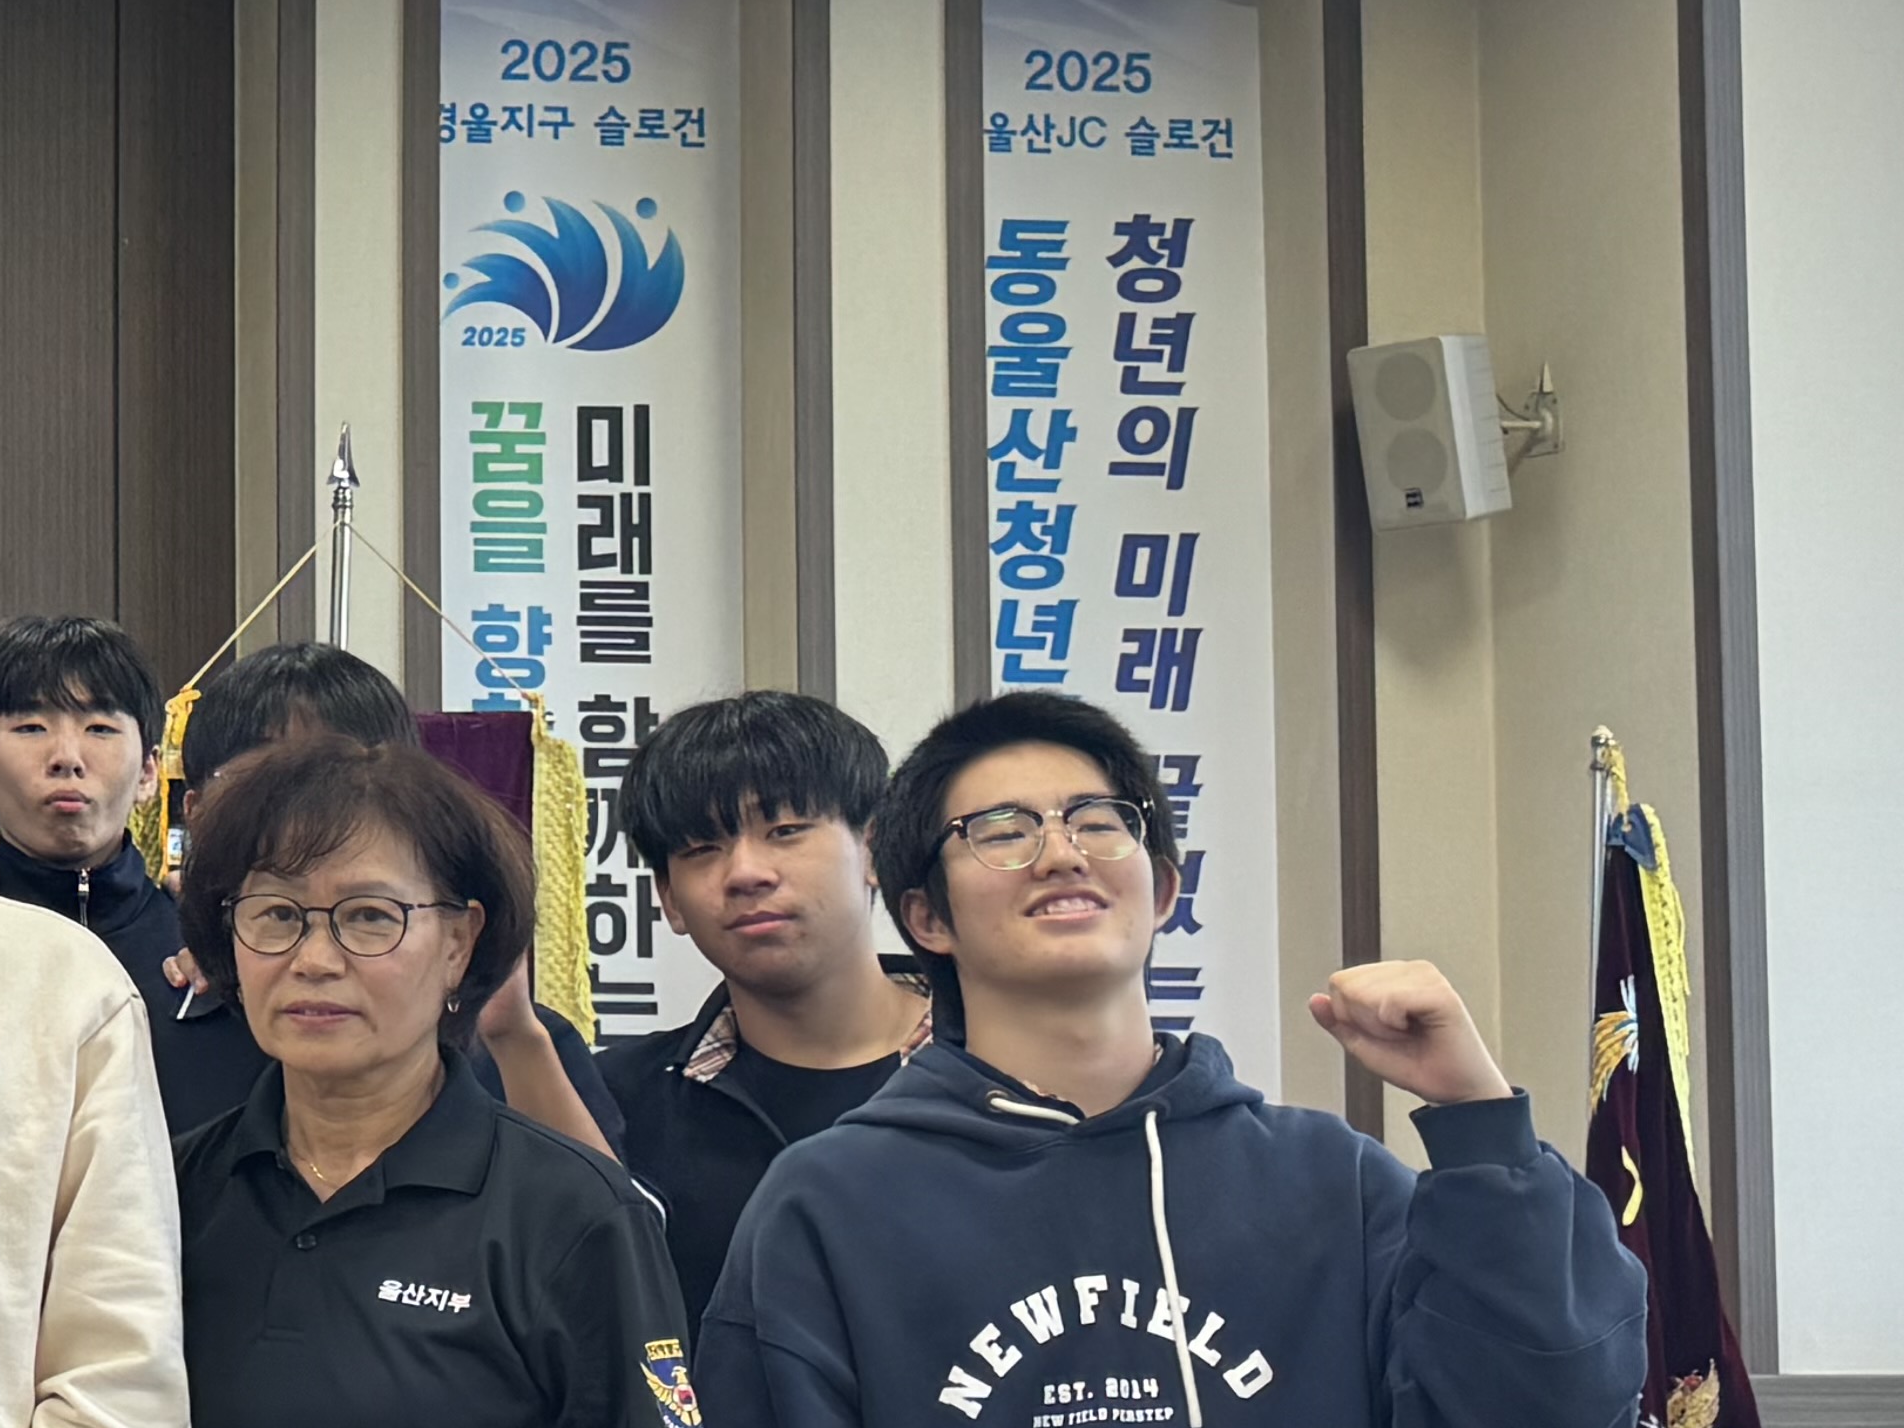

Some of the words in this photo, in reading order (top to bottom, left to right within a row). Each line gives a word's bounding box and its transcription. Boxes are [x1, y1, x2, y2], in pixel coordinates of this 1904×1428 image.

[500, 39, 632, 83] 2025
[1024, 49, 1152, 94] 2025
[594, 106, 706, 148] 슬로건
[983, 112, 1107, 154] 울산JC
[1124, 117, 1234, 159] 슬로건
[461, 326, 526, 347] 2025
[1106, 214, 1199, 490] 청년의
[985, 218, 1080, 702] 동울산청년
[469, 401, 547, 573] 꿈을
[576, 404, 653, 664] 미래를
[1114, 533, 1204, 711] 미래
[471, 603, 553, 730] 향
[378, 1279, 471, 1313] 울산지부
[938, 1274, 1274, 1419] NEWFIELD
[1044, 1381, 1094, 1404] EST.
[1105, 1377, 1159, 1399] 2014
[1033, 1414, 1064, 1428] NEW
[1068, 1407, 1108, 1425] FIELD
